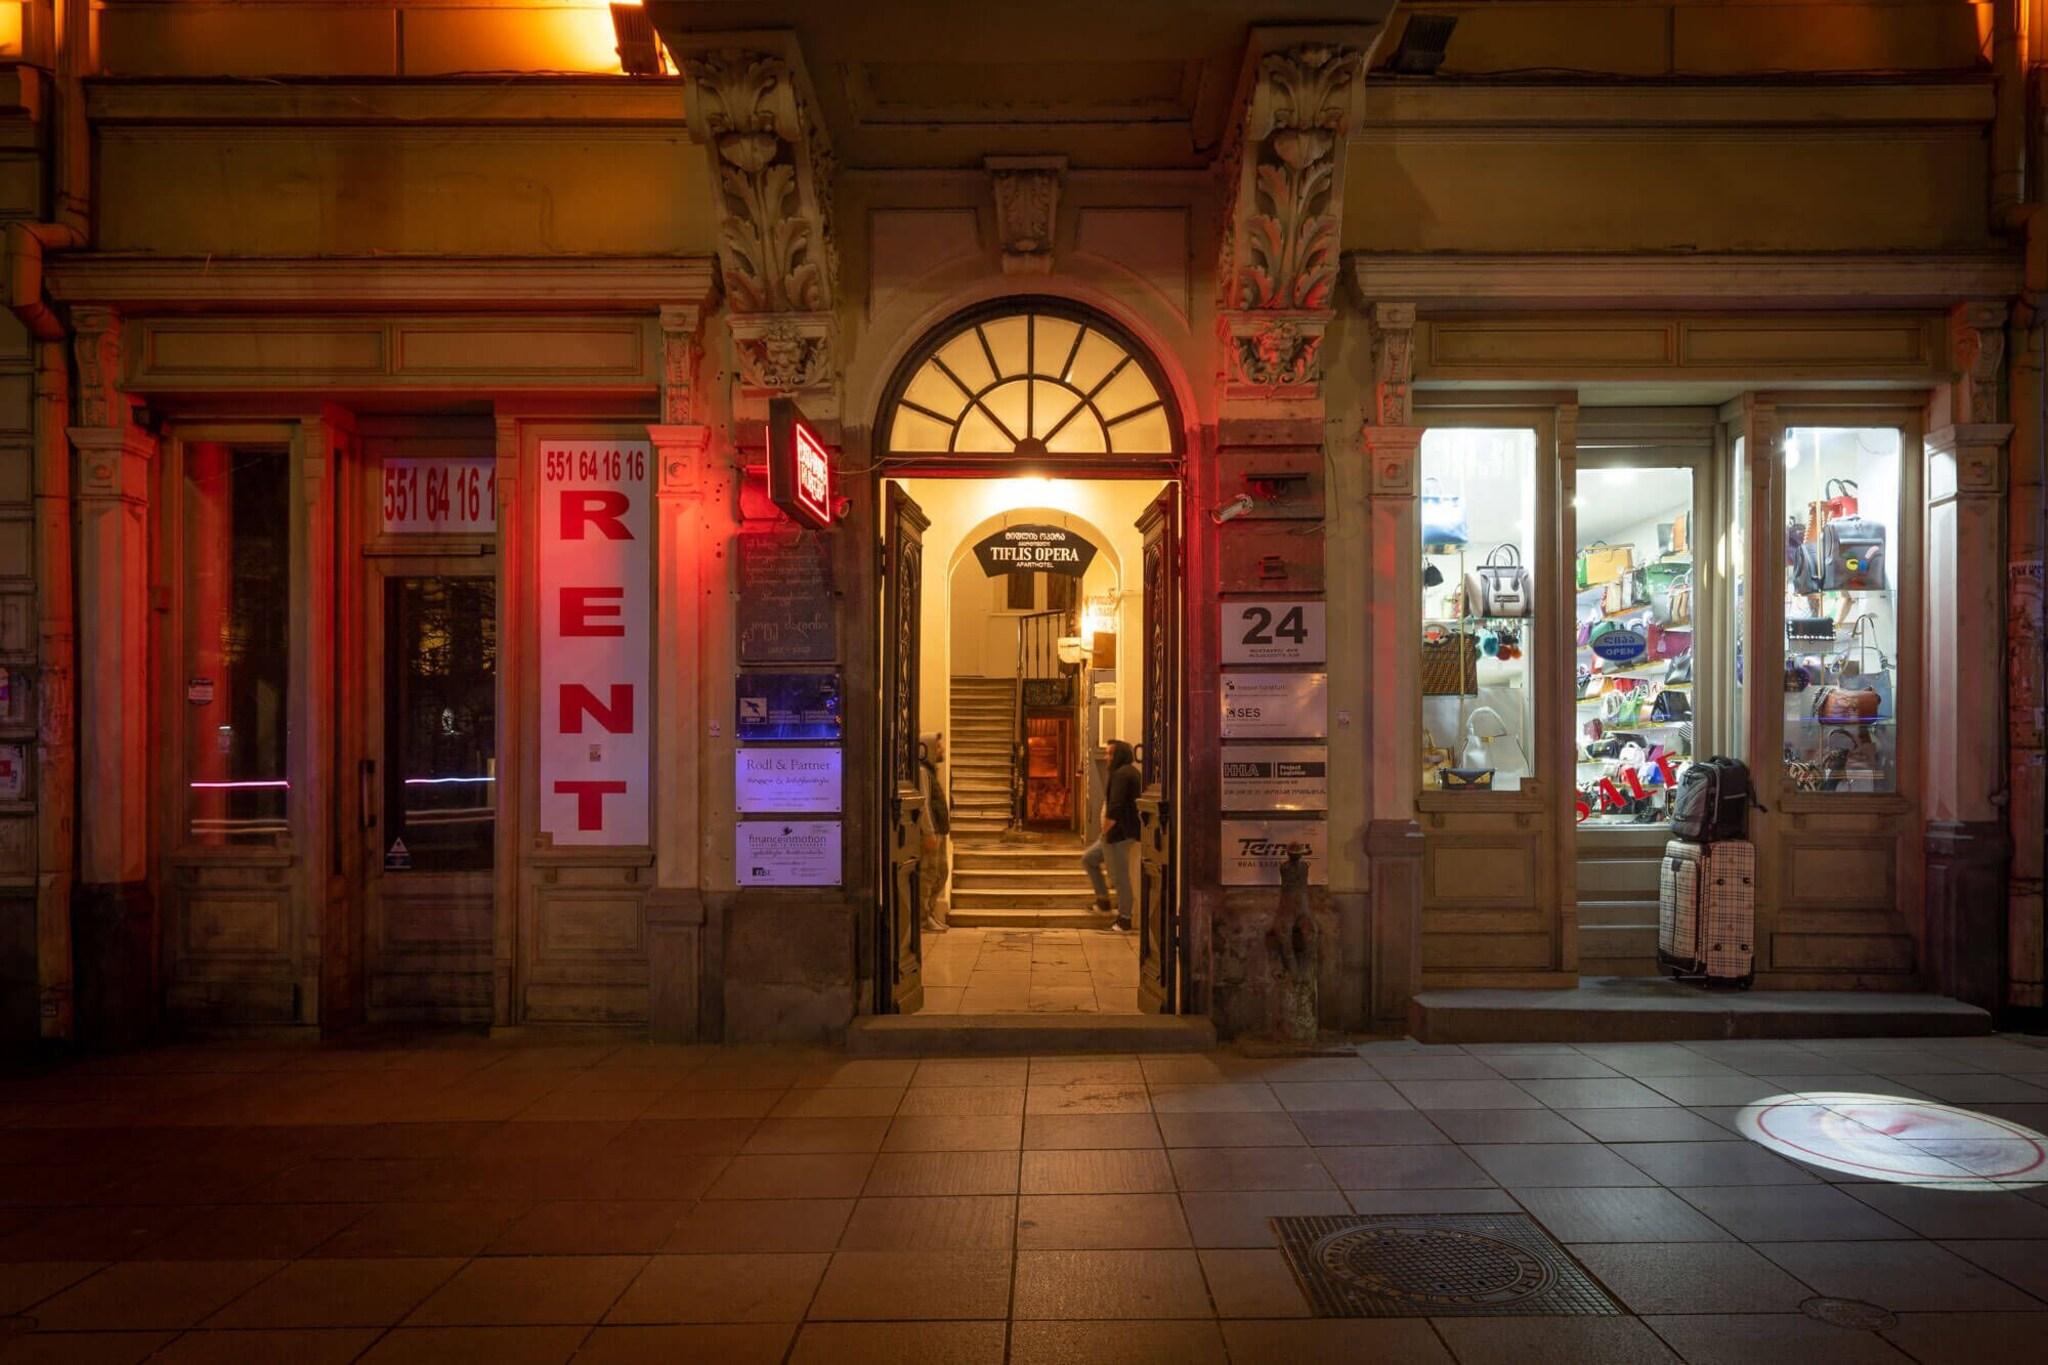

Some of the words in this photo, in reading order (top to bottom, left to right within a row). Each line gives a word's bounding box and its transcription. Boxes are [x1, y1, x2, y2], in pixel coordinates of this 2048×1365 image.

[546, 451, 573, 481] 551
[579, 451, 597, 481] 64
[603, 451, 621, 481] 16
[626, 451, 644, 481] 16
[384, 467, 417, 521] 551
[426, 467, 449, 521] 64
[457, 467, 480, 521] 16
[990, 546, 1032, 560] TIFLIS
[1034, 547, 1079, 561] OPERA
[1242, 606, 1308, 645] 24
[553, 490, 635, 831] RENT
[1605, 648, 1634, 656] OPEN
